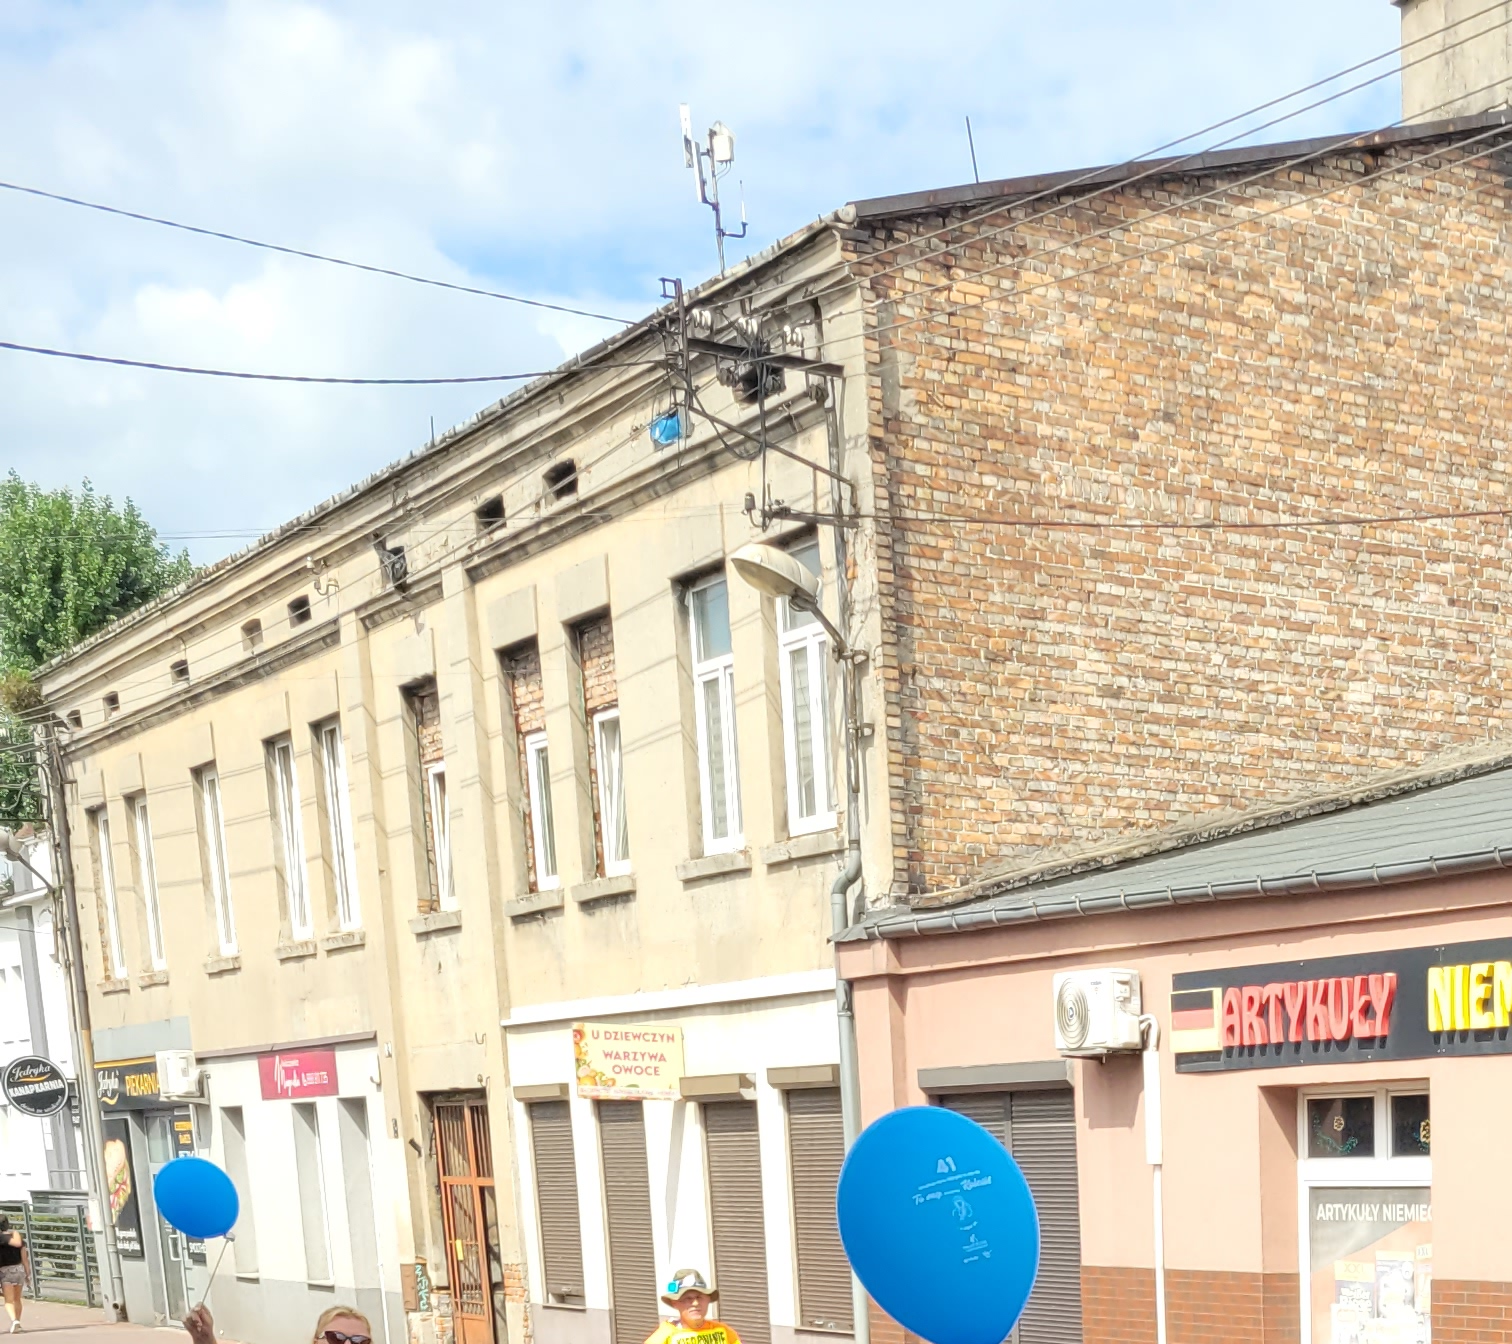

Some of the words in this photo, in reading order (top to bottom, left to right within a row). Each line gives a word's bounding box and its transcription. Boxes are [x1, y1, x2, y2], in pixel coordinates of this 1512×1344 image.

[1221, 971, 1397, 1047] ARTYKUŁY
[591, 1029, 600, 1040] U
[604, 1030, 675, 1043] DZIEWCZYN
[602, 1049, 667, 1063] WARZYWA
[612, 1064, 660, 1076] OWOCE
[8, 1078, 64, 1098] KANAPKARNIA
[1316, 1203, 1380, 1222] ARTYKUŁY
